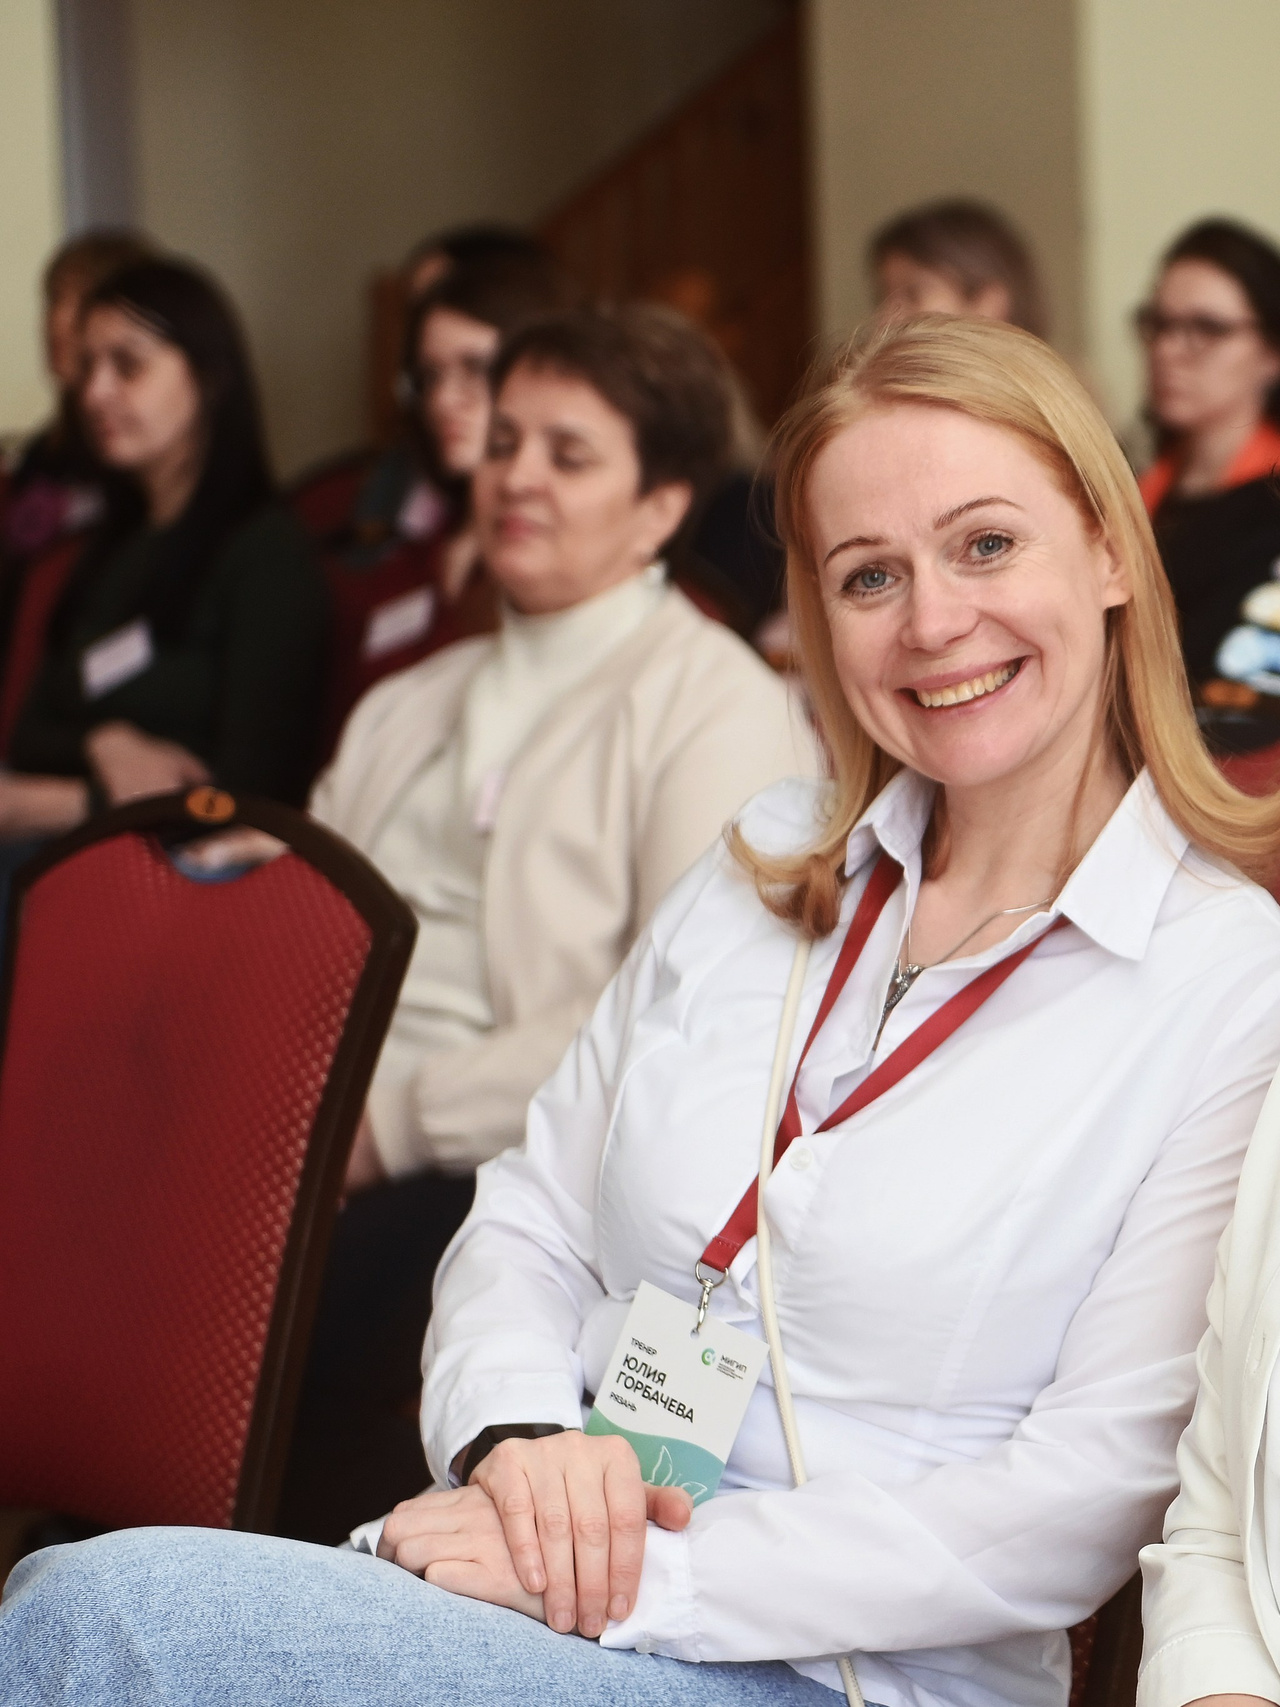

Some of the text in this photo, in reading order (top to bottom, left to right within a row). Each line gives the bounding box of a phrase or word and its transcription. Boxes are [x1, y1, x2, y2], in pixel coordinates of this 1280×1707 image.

[631, 1337, 658, 1356] ТРЕНЕР
[622, 1353, 667, 1387] ЮЛИЯ
[609, 1391, 637, 1412] РЯЗАНЬ
[616, 1371, 694, 1423] ГОРБАЧЕВА
